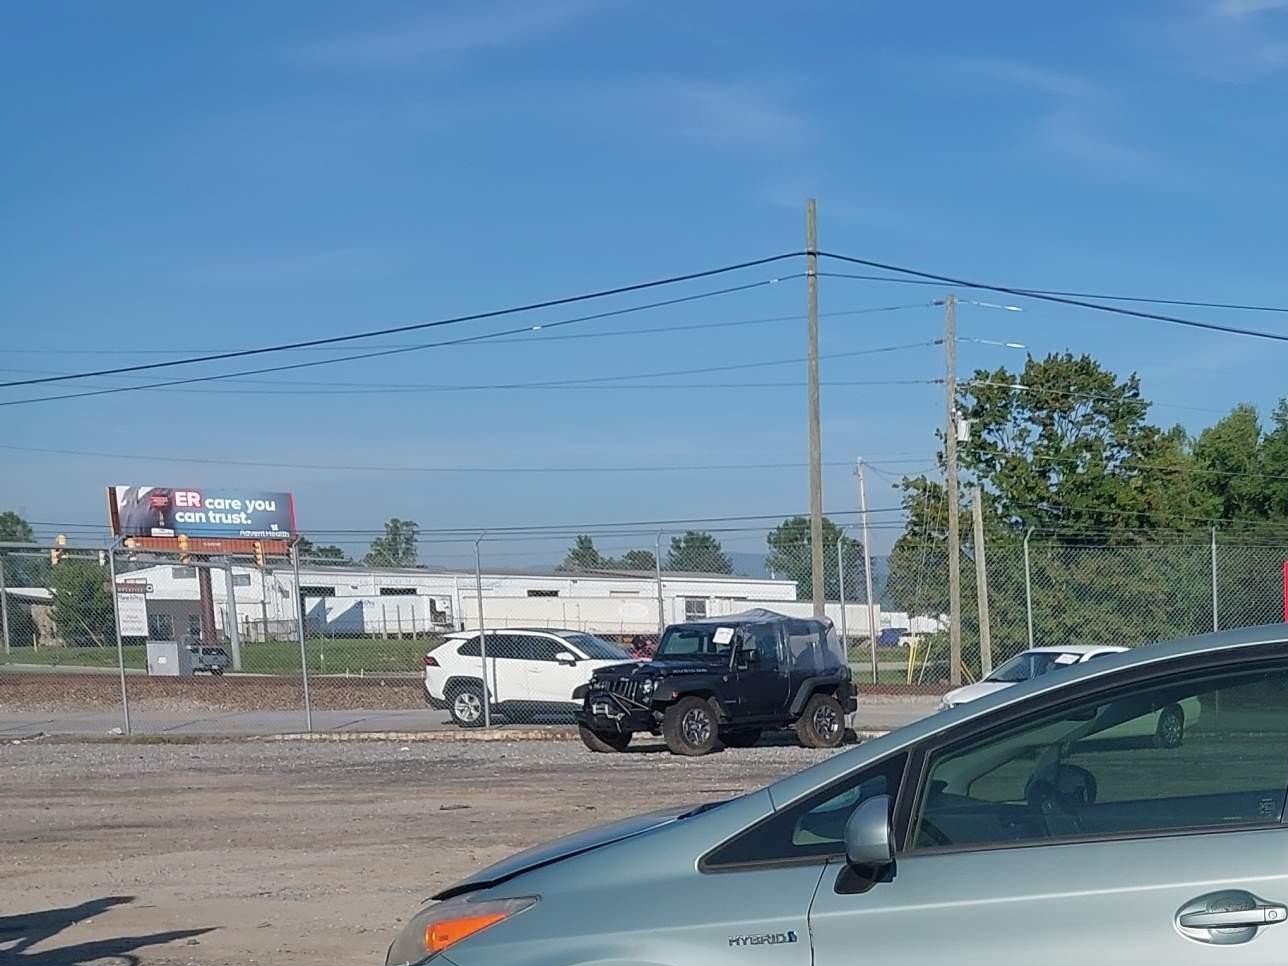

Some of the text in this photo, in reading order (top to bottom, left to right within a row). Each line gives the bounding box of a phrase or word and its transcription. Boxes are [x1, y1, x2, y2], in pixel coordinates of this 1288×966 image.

[175, 491, 200, 507] ER
[205, 498, 241, 510] care
[245, 499, 276, 514] you
[175, 511, 206, 523] can
[209, 510, 252, 525] trust.
[728, 933, 786, 946] HYBRID
